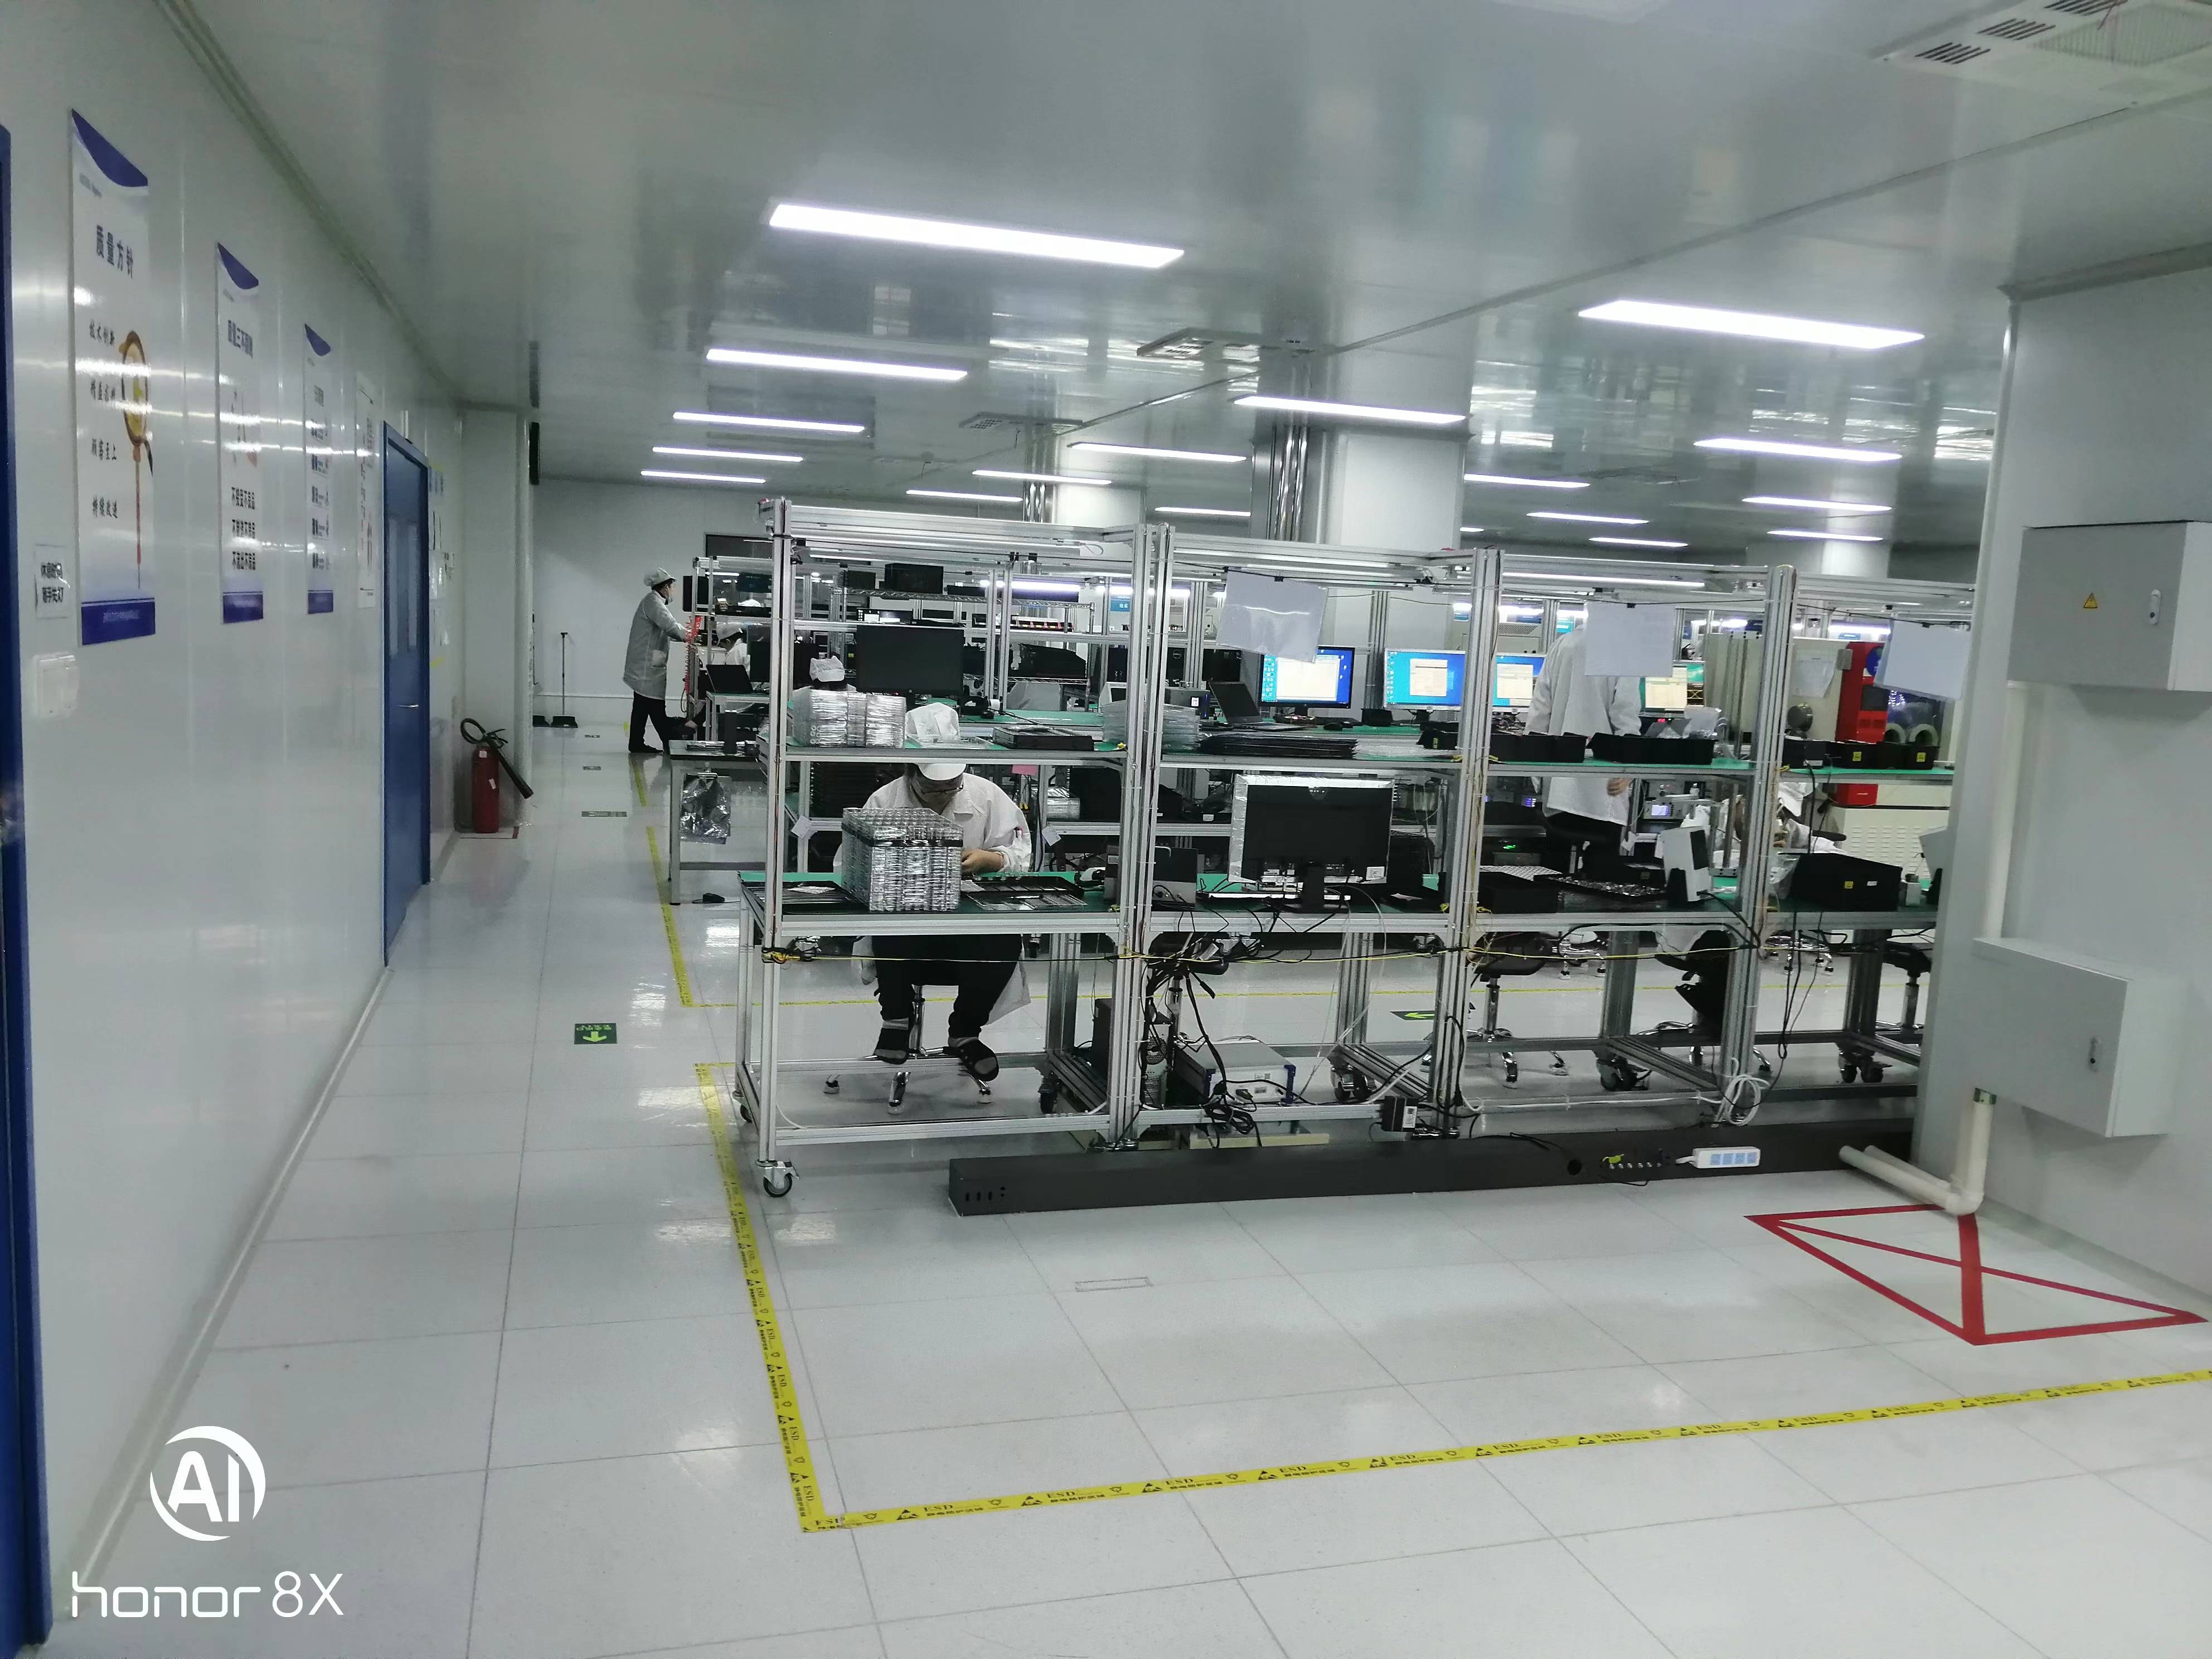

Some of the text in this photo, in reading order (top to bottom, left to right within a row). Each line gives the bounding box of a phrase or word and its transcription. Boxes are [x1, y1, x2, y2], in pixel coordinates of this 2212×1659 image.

[96, 225, 134, 279] 质量方针
[767, 1328, 775, 1340] ESD
[778, 1374, 787, 1387] ESD
[789, 1426, 799, 1440] ESD
[803, 1485, 814, 1501] ESD
